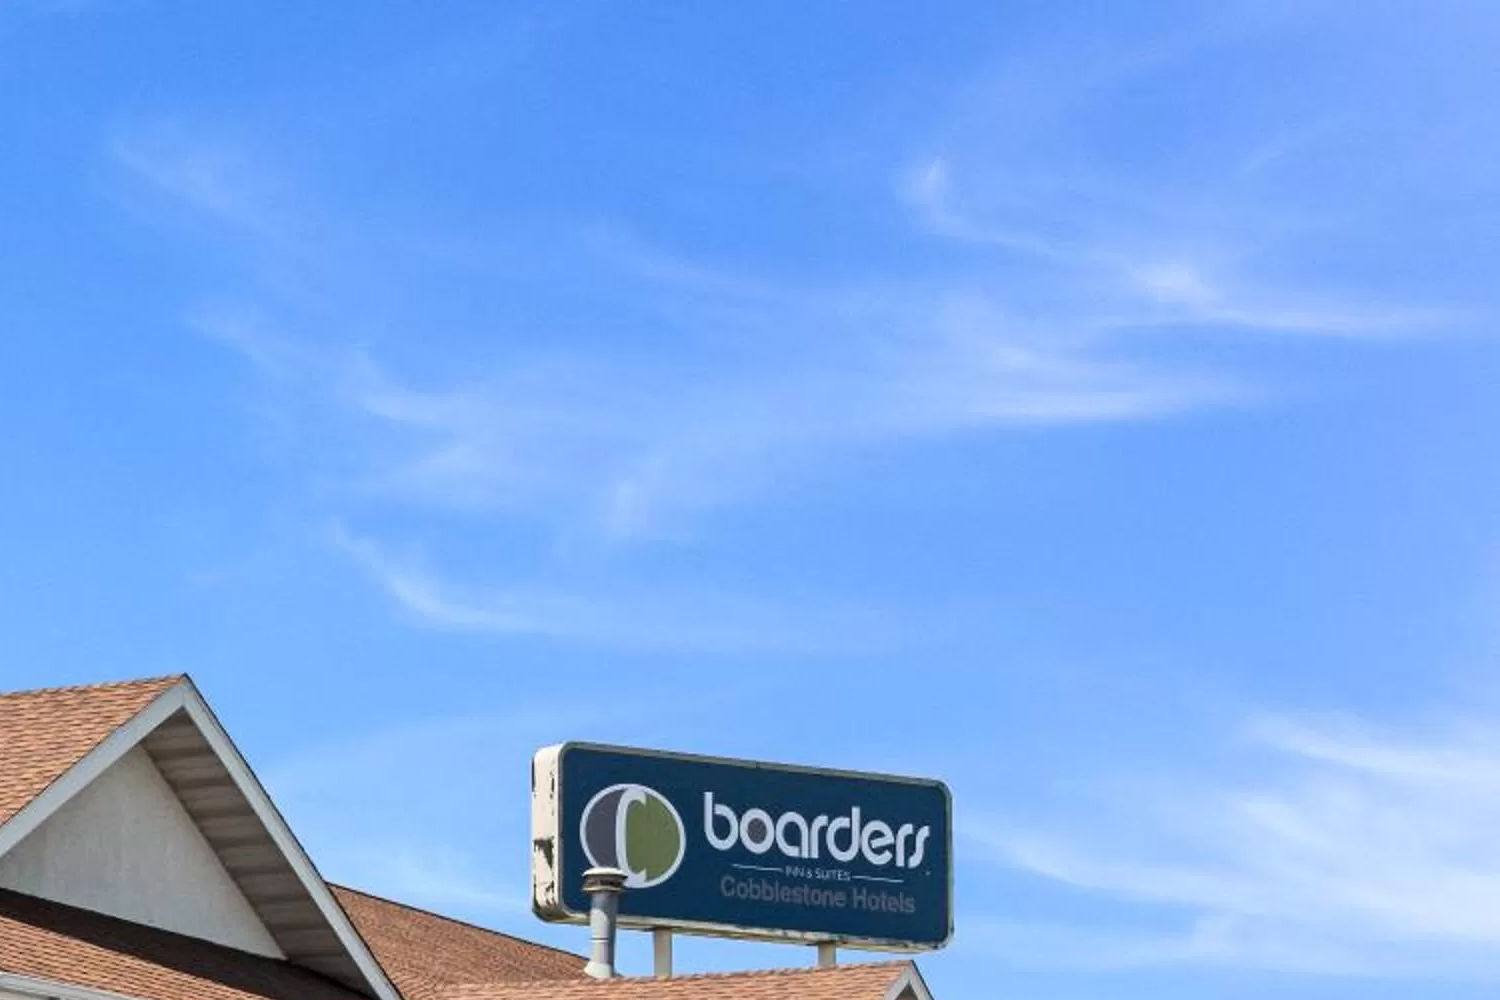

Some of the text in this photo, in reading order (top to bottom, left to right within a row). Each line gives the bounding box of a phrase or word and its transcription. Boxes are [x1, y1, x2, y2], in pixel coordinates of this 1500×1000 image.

[703, 791, 931, 869] boarders
[720, 875, 917, 913] Cobblestone Hotels
